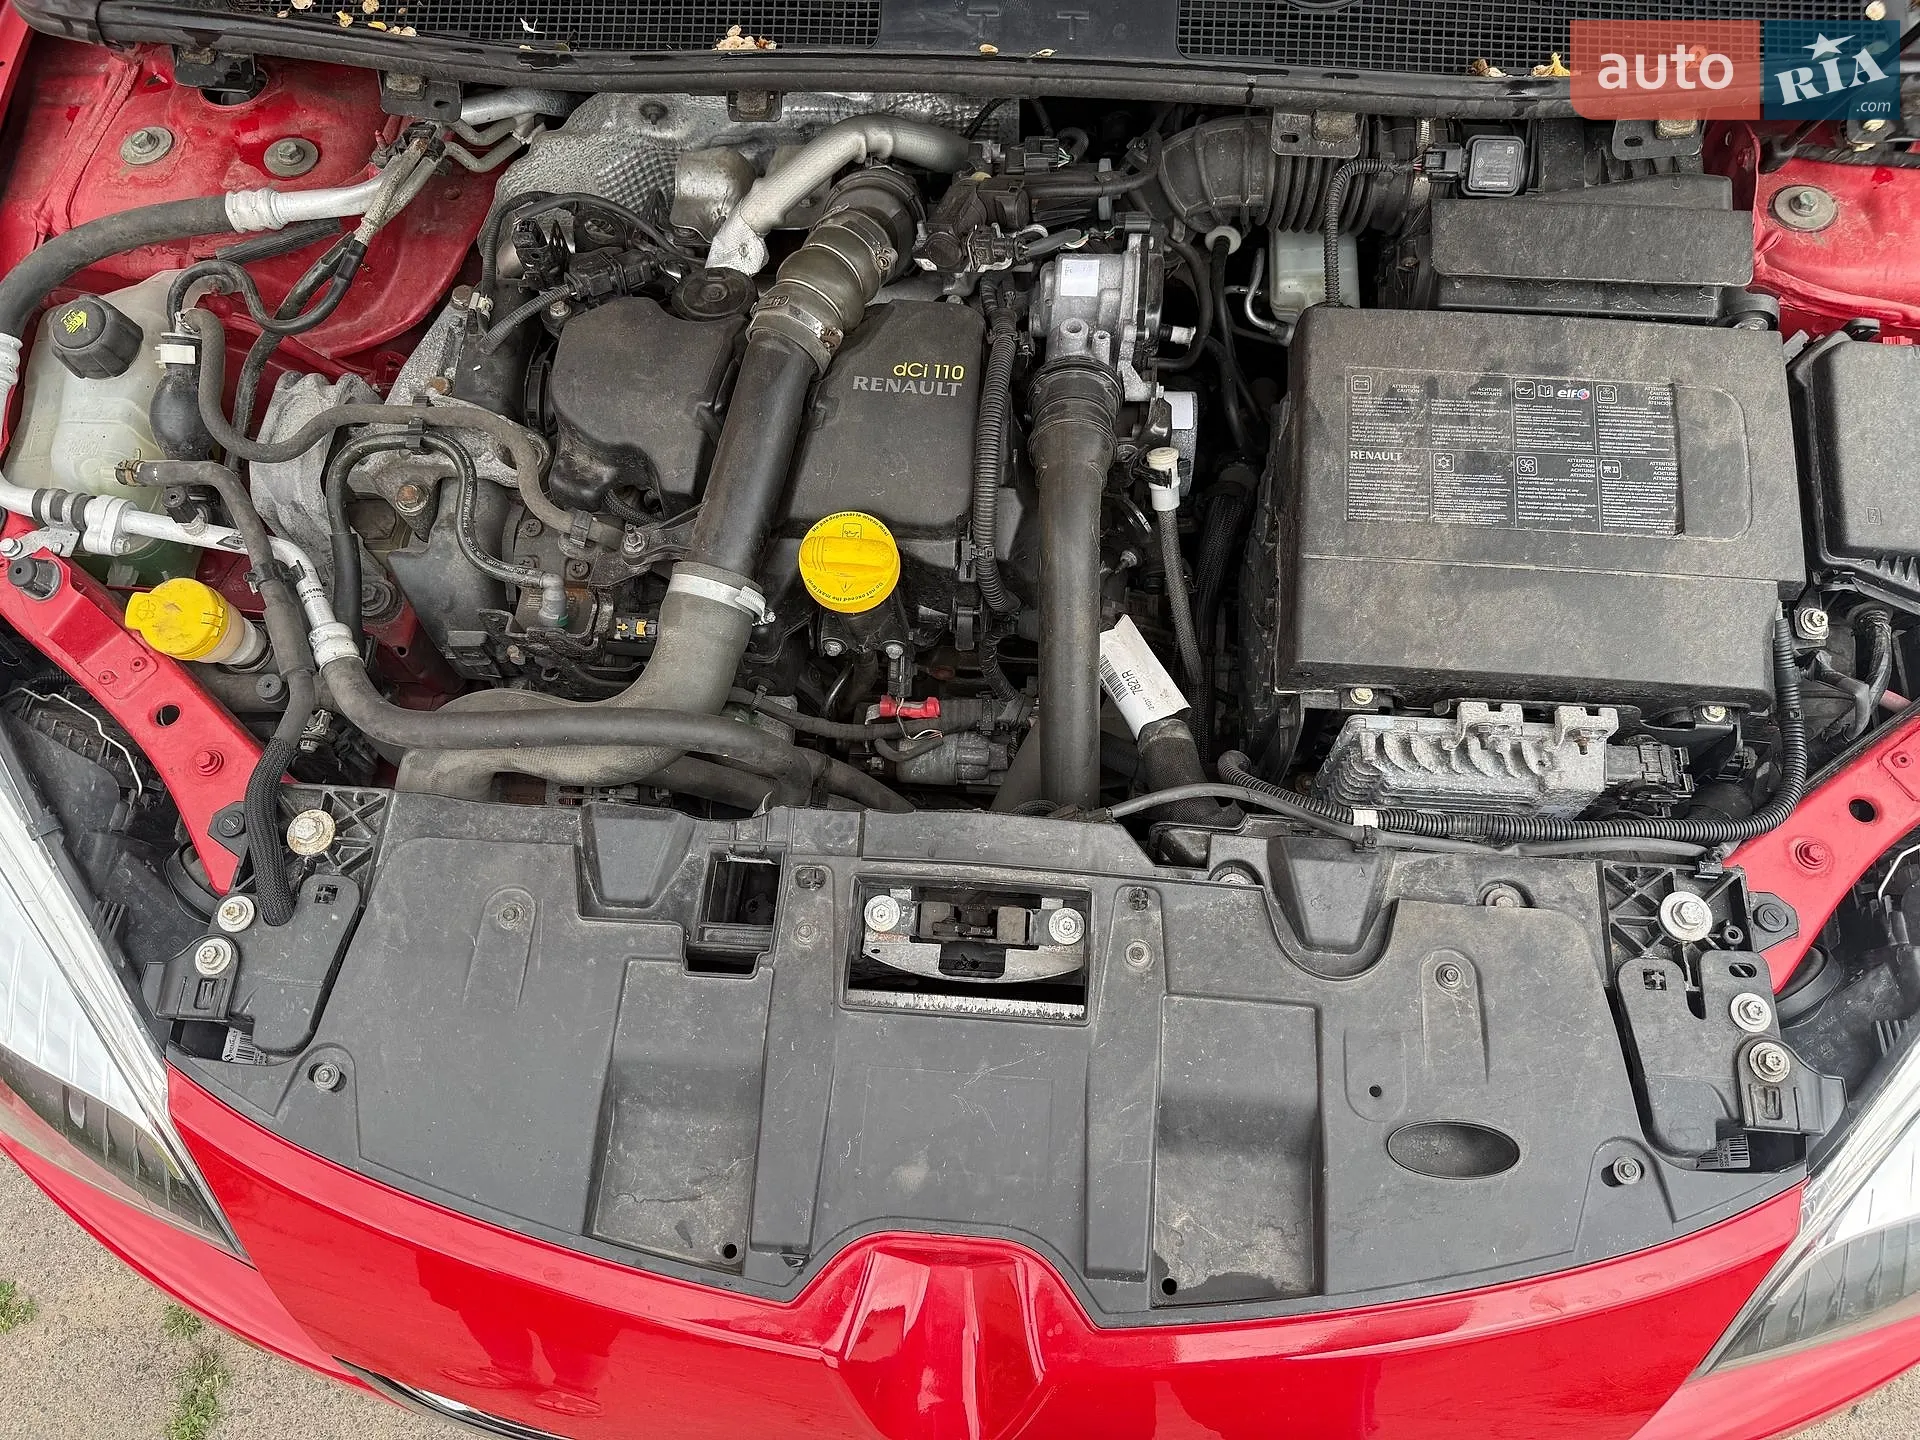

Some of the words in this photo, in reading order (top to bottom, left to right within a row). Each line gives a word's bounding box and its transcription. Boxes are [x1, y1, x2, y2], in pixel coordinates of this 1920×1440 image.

[893, 361, 928, 378] dCi
[934, 364, 965, 380] 110
[852, 375, 963, 397] RENAULT
[1350, 450, 1403, 461] RENAULT
[820, 518, 829, 527] pas
[862, 515, 880, 526] niveau
[843, 594, 865, 602] exceed
